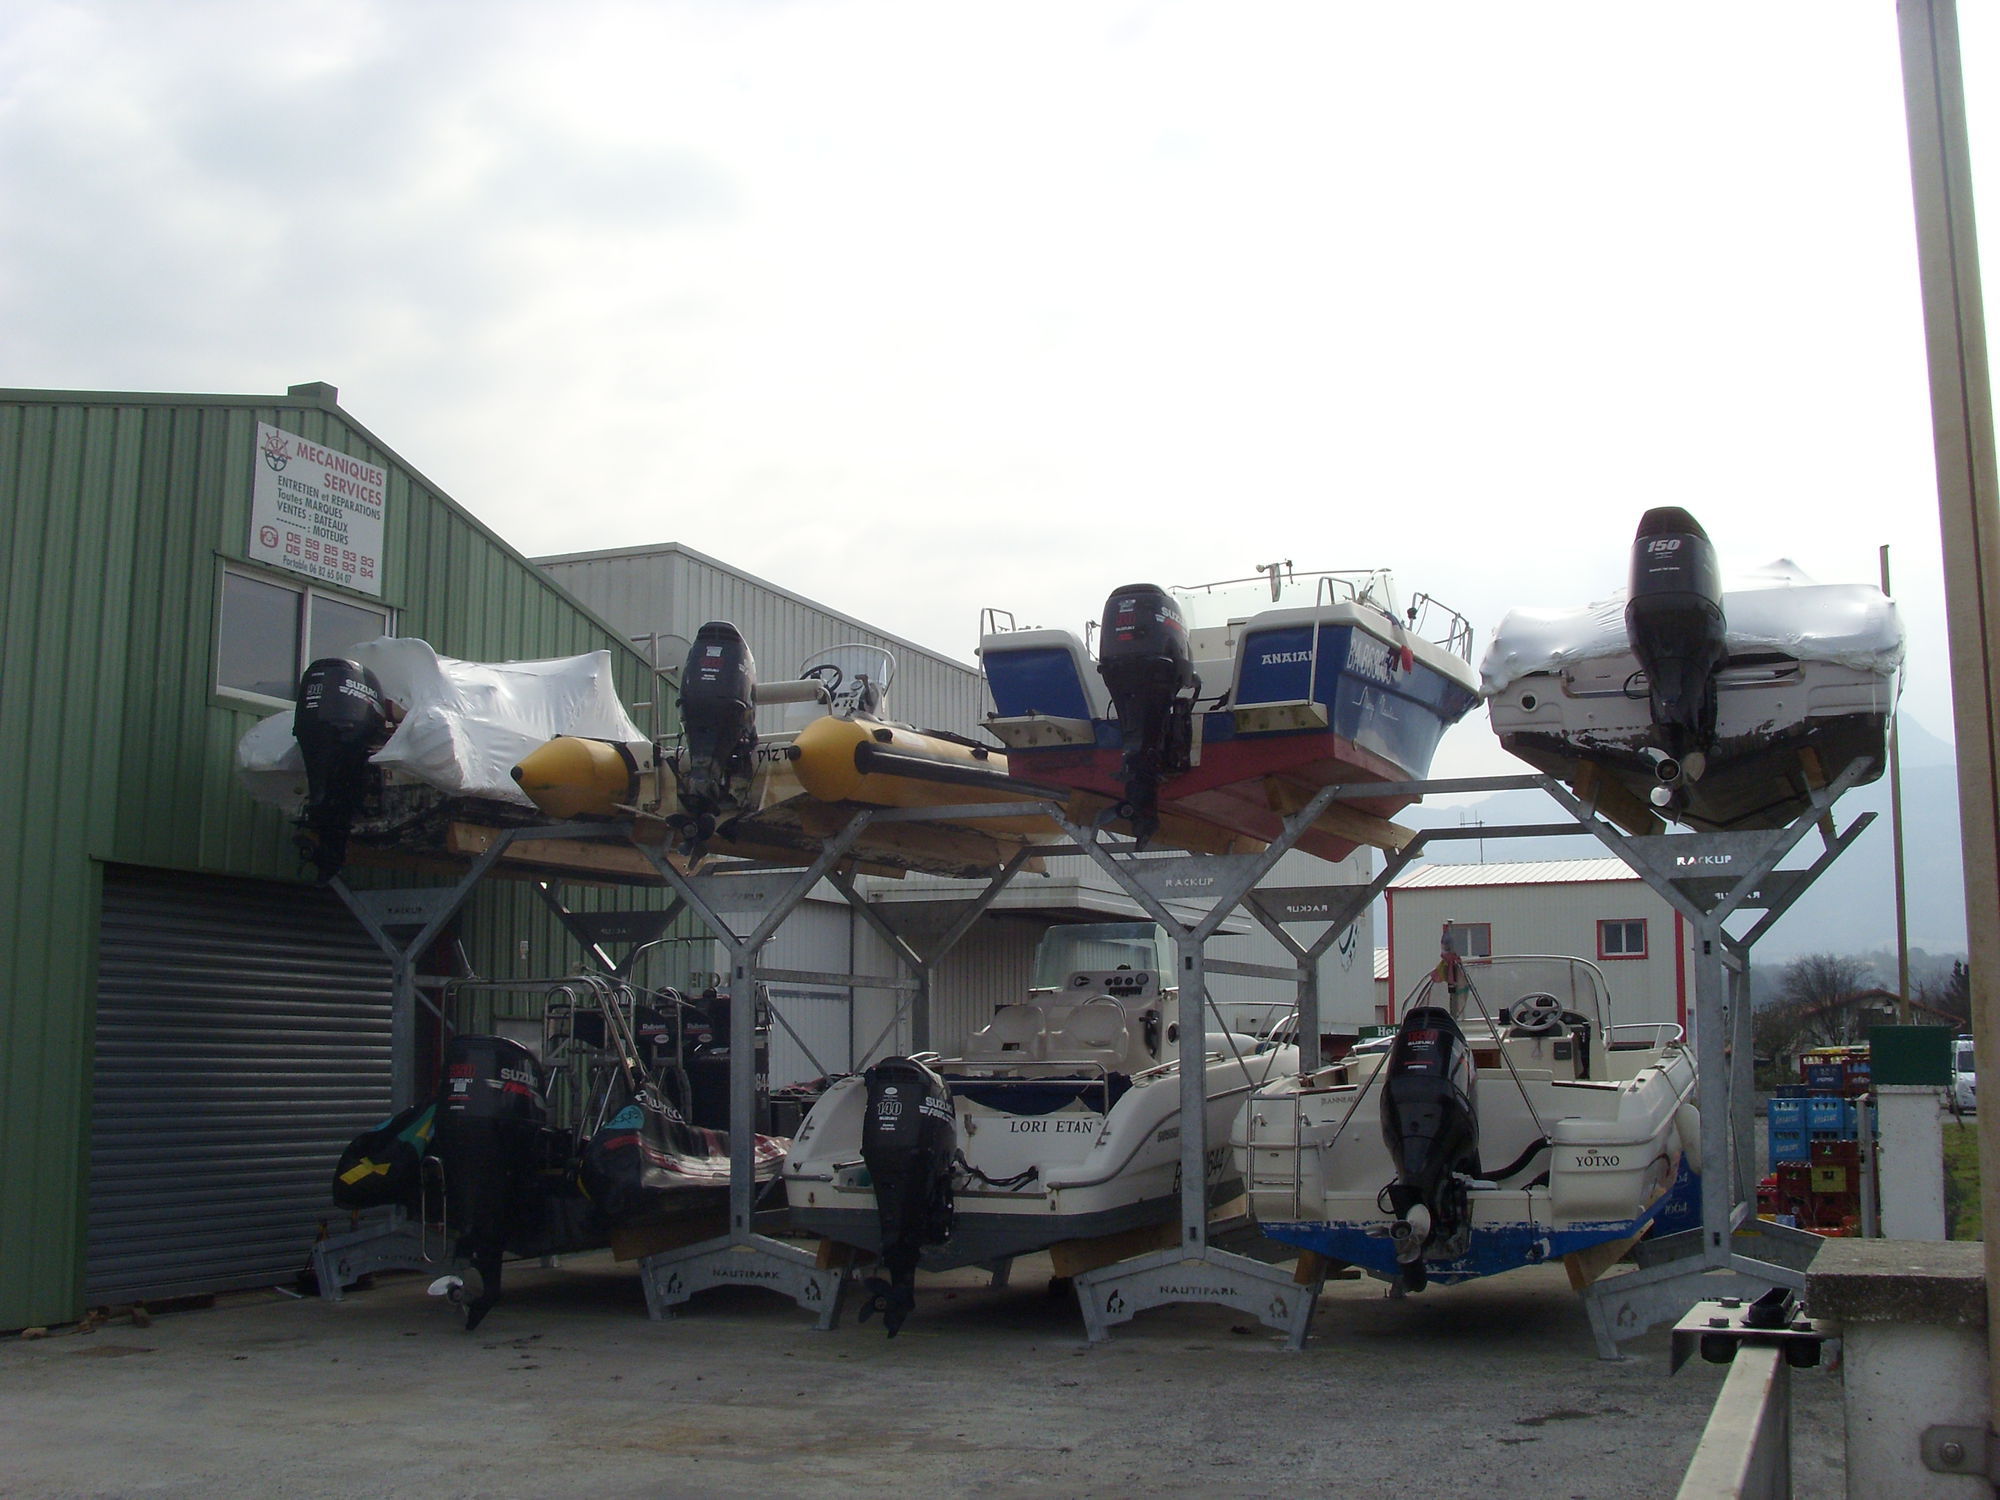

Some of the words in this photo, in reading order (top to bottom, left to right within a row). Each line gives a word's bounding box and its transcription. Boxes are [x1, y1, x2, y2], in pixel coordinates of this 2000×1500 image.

[297, 442, 383, 486] MECANIQUES
[278, 475, 319, 498] ENTRETIEN
[324, 473, 382, 506] SERVICES
[278, 488, 303, 505] Toutes
[305, 498, 343, 519] MARQUES
[277, 501, 306, 519] VENTES
[315, 514, 348, 533] BATEAUX
[313, 526, 348, 545] MOTEURS
[287, 532, 301, 544] 05
[306, 538, 320, 550] 59
[324, 544, 338, 556] 85
[343, 550, 357, 561] 93
[361, 556, 374, 567] 93
[1648, 539, 1680, 552] 150
[286, 544, 300, 556] 05
[305, 549, 319, 561] 59
[342, 561, 356, 573] 93
[360, 567, 374, 579] 94
[1676, 855, 1732, 865] RACKUP
[1165, 878, 1213, 887] RACKUP
[878, 1101, 902, 1116] 140
[1010, 1120, 1047, 1133] LORI
[1056, 1120, 1093, 1133] ETAN
[1576, 1155, 1620, 1167] YOTXO
[1159, 1286, 1238, 1296] NAUTIPARK
